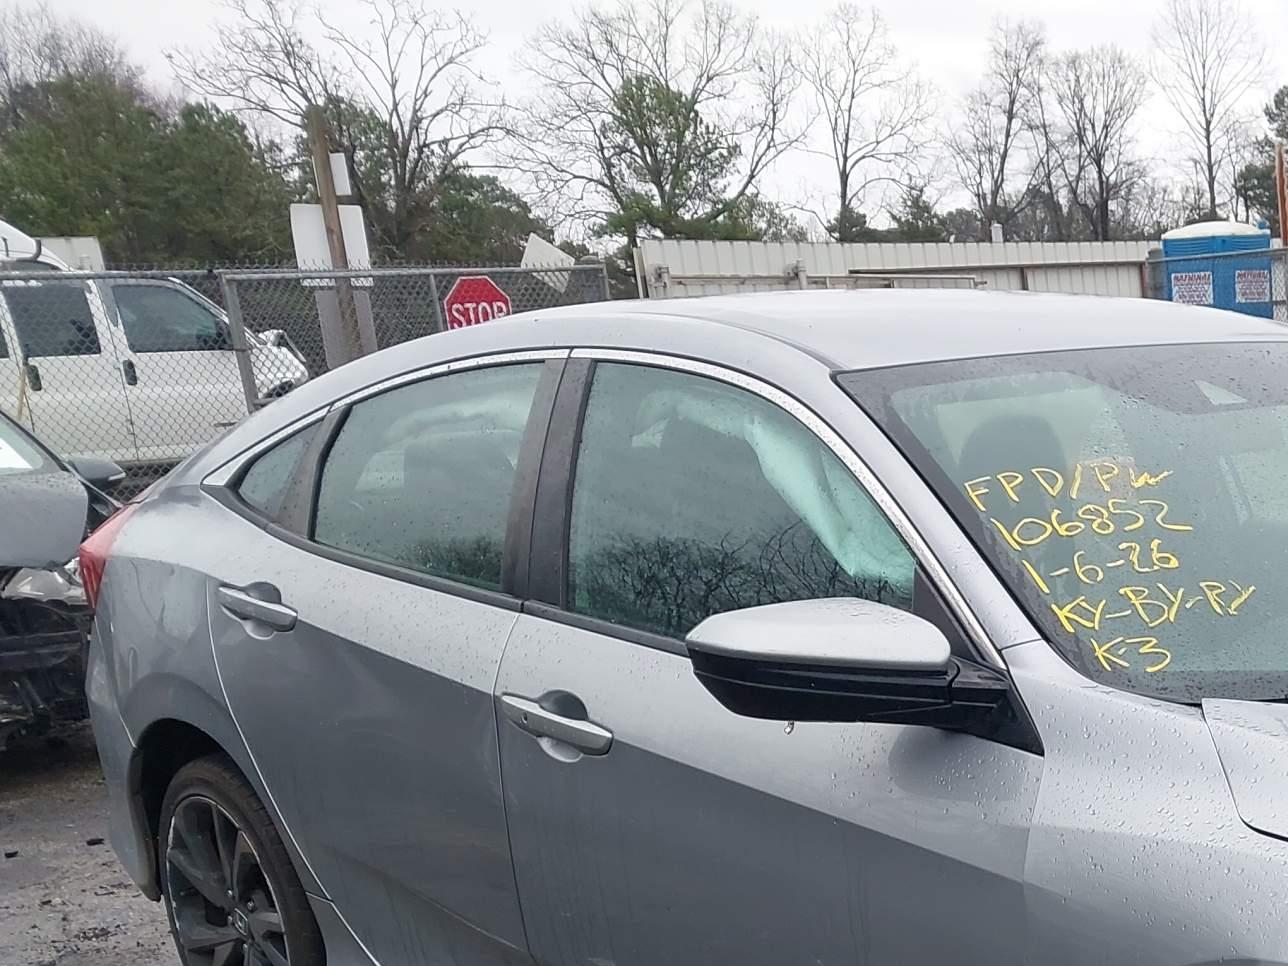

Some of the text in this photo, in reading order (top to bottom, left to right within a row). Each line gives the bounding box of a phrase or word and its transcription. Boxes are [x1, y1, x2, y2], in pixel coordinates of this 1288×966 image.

[451, 301, 507, 328] STOP
[990, 499, 1193, 551] 106852
[1021, 538, 1180, 594] 1-6-26
